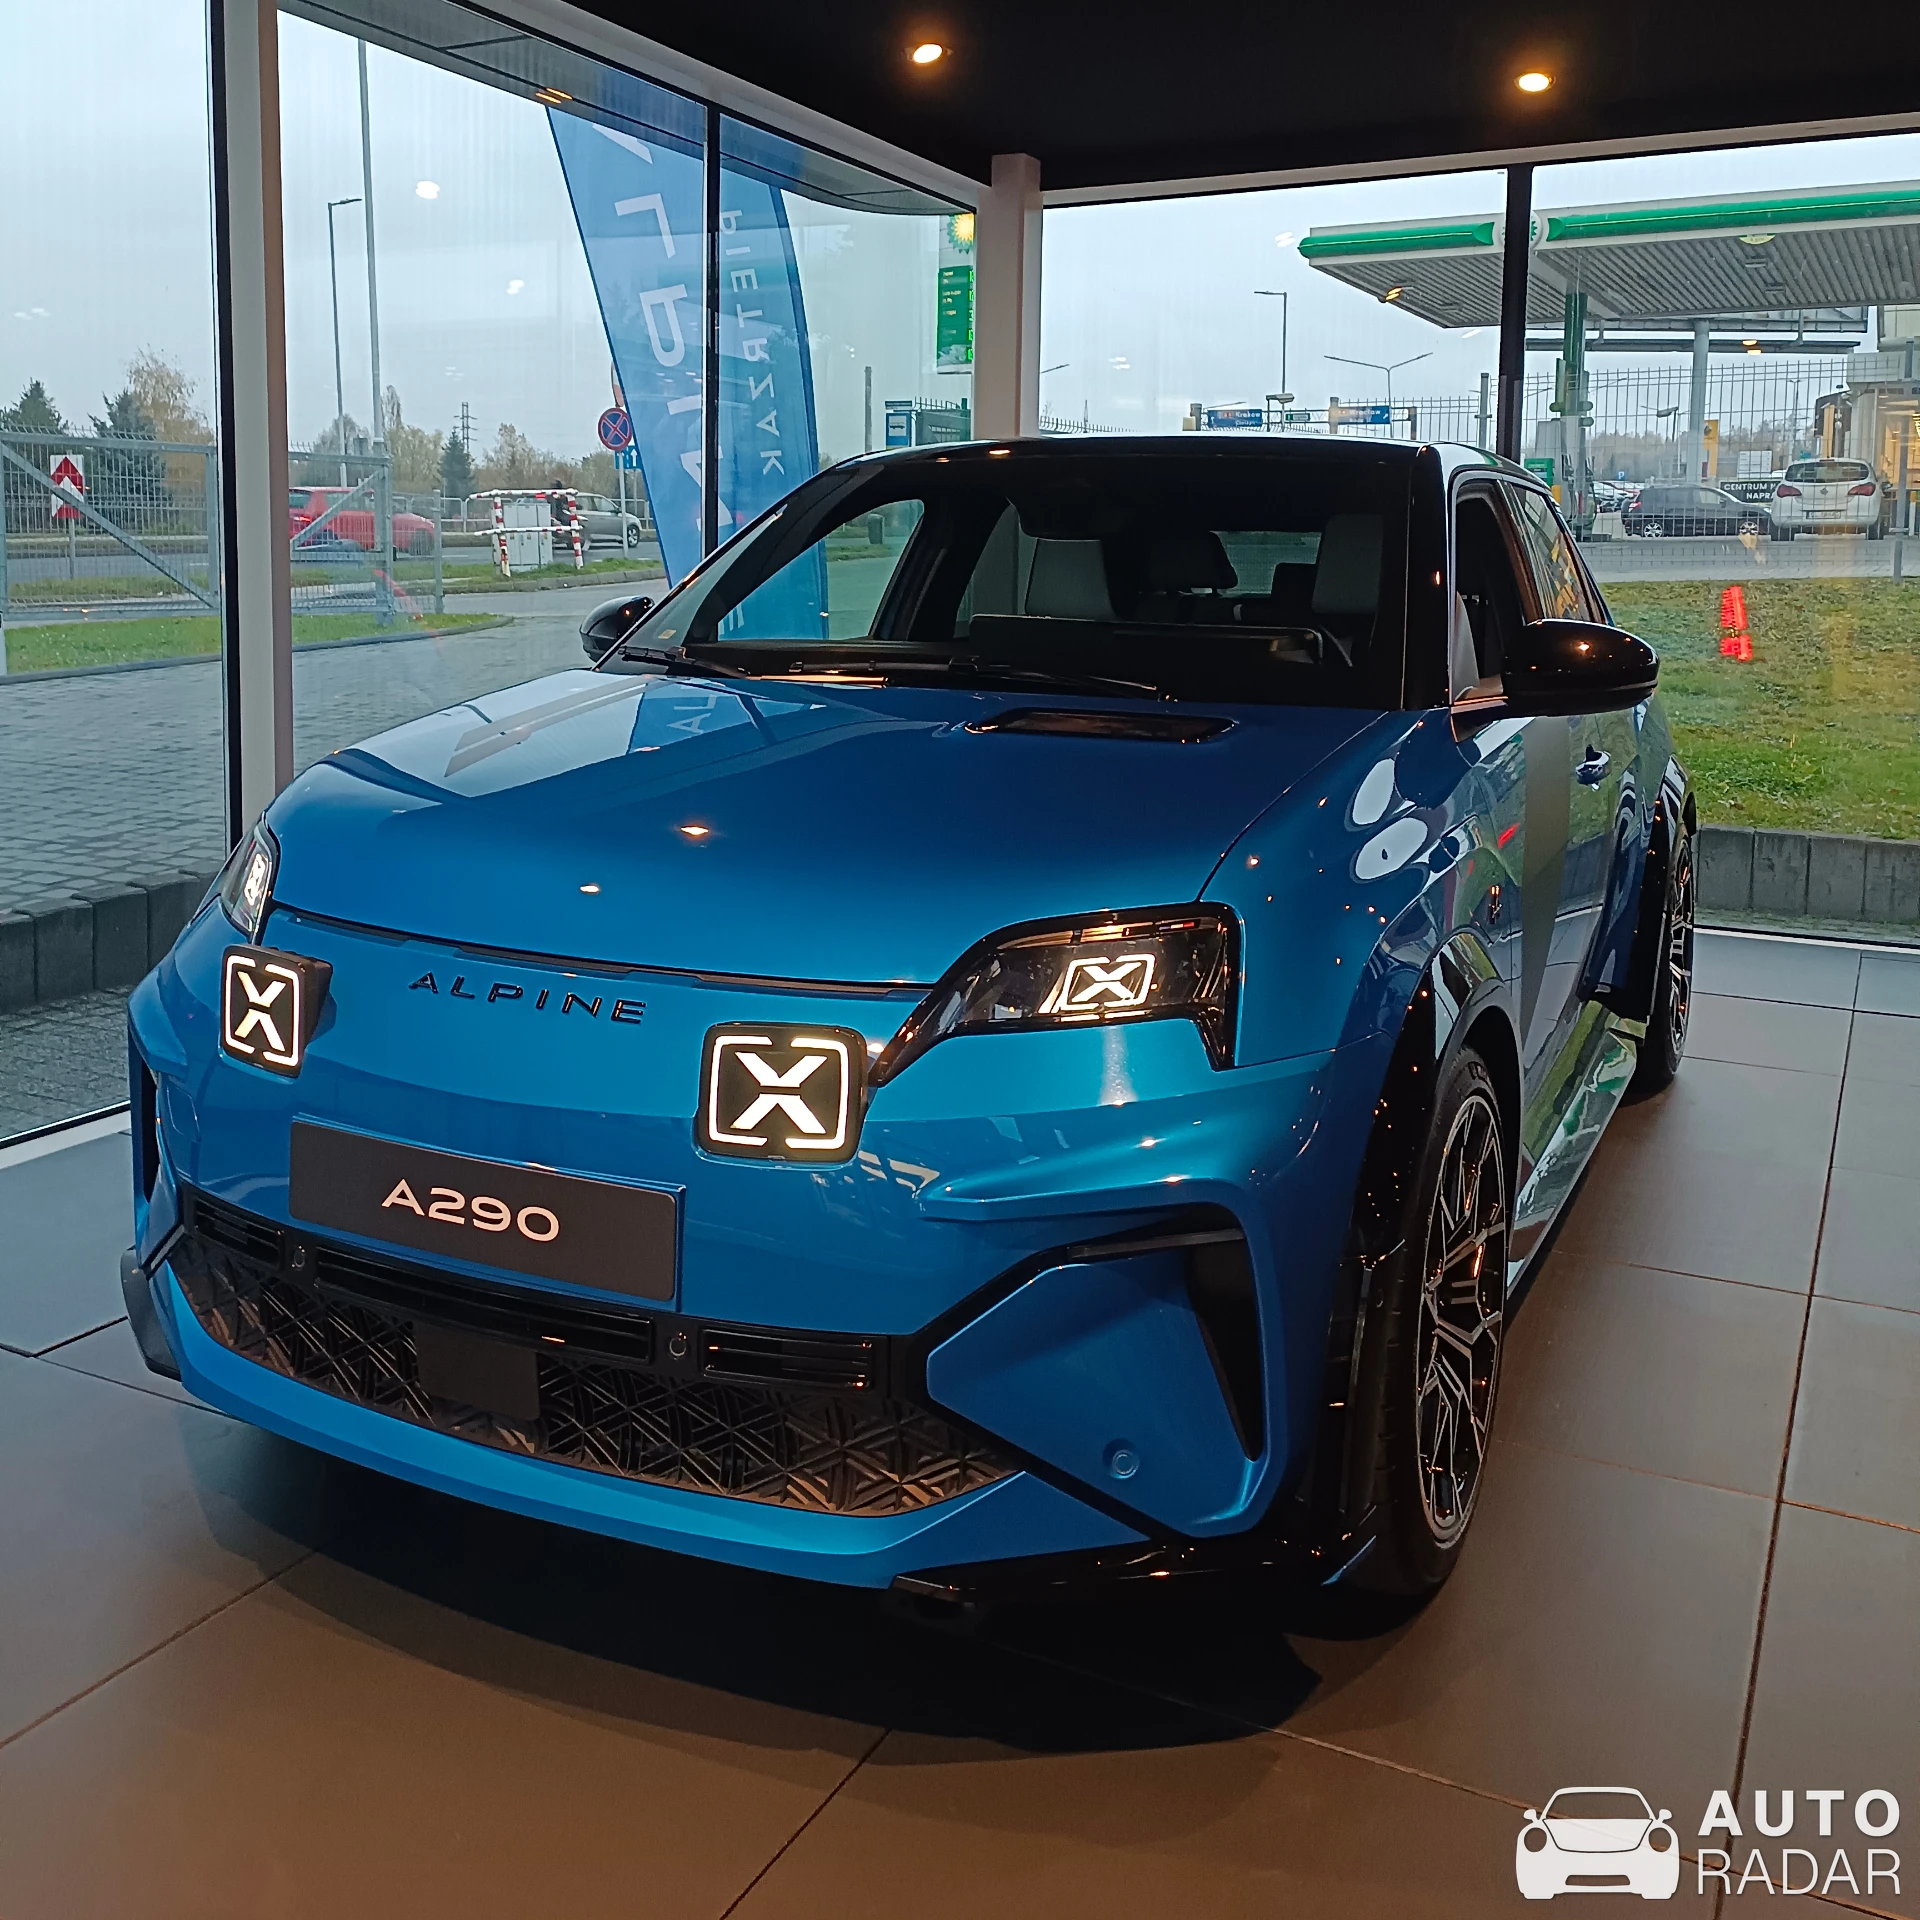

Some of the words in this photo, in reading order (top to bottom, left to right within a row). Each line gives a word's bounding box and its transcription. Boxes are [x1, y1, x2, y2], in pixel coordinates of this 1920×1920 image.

[1723, 483, 1767, 491] CENTRUM
[408, 971, 649, 1025] ALPINE
[381, 1178, 560, 1243] A290
